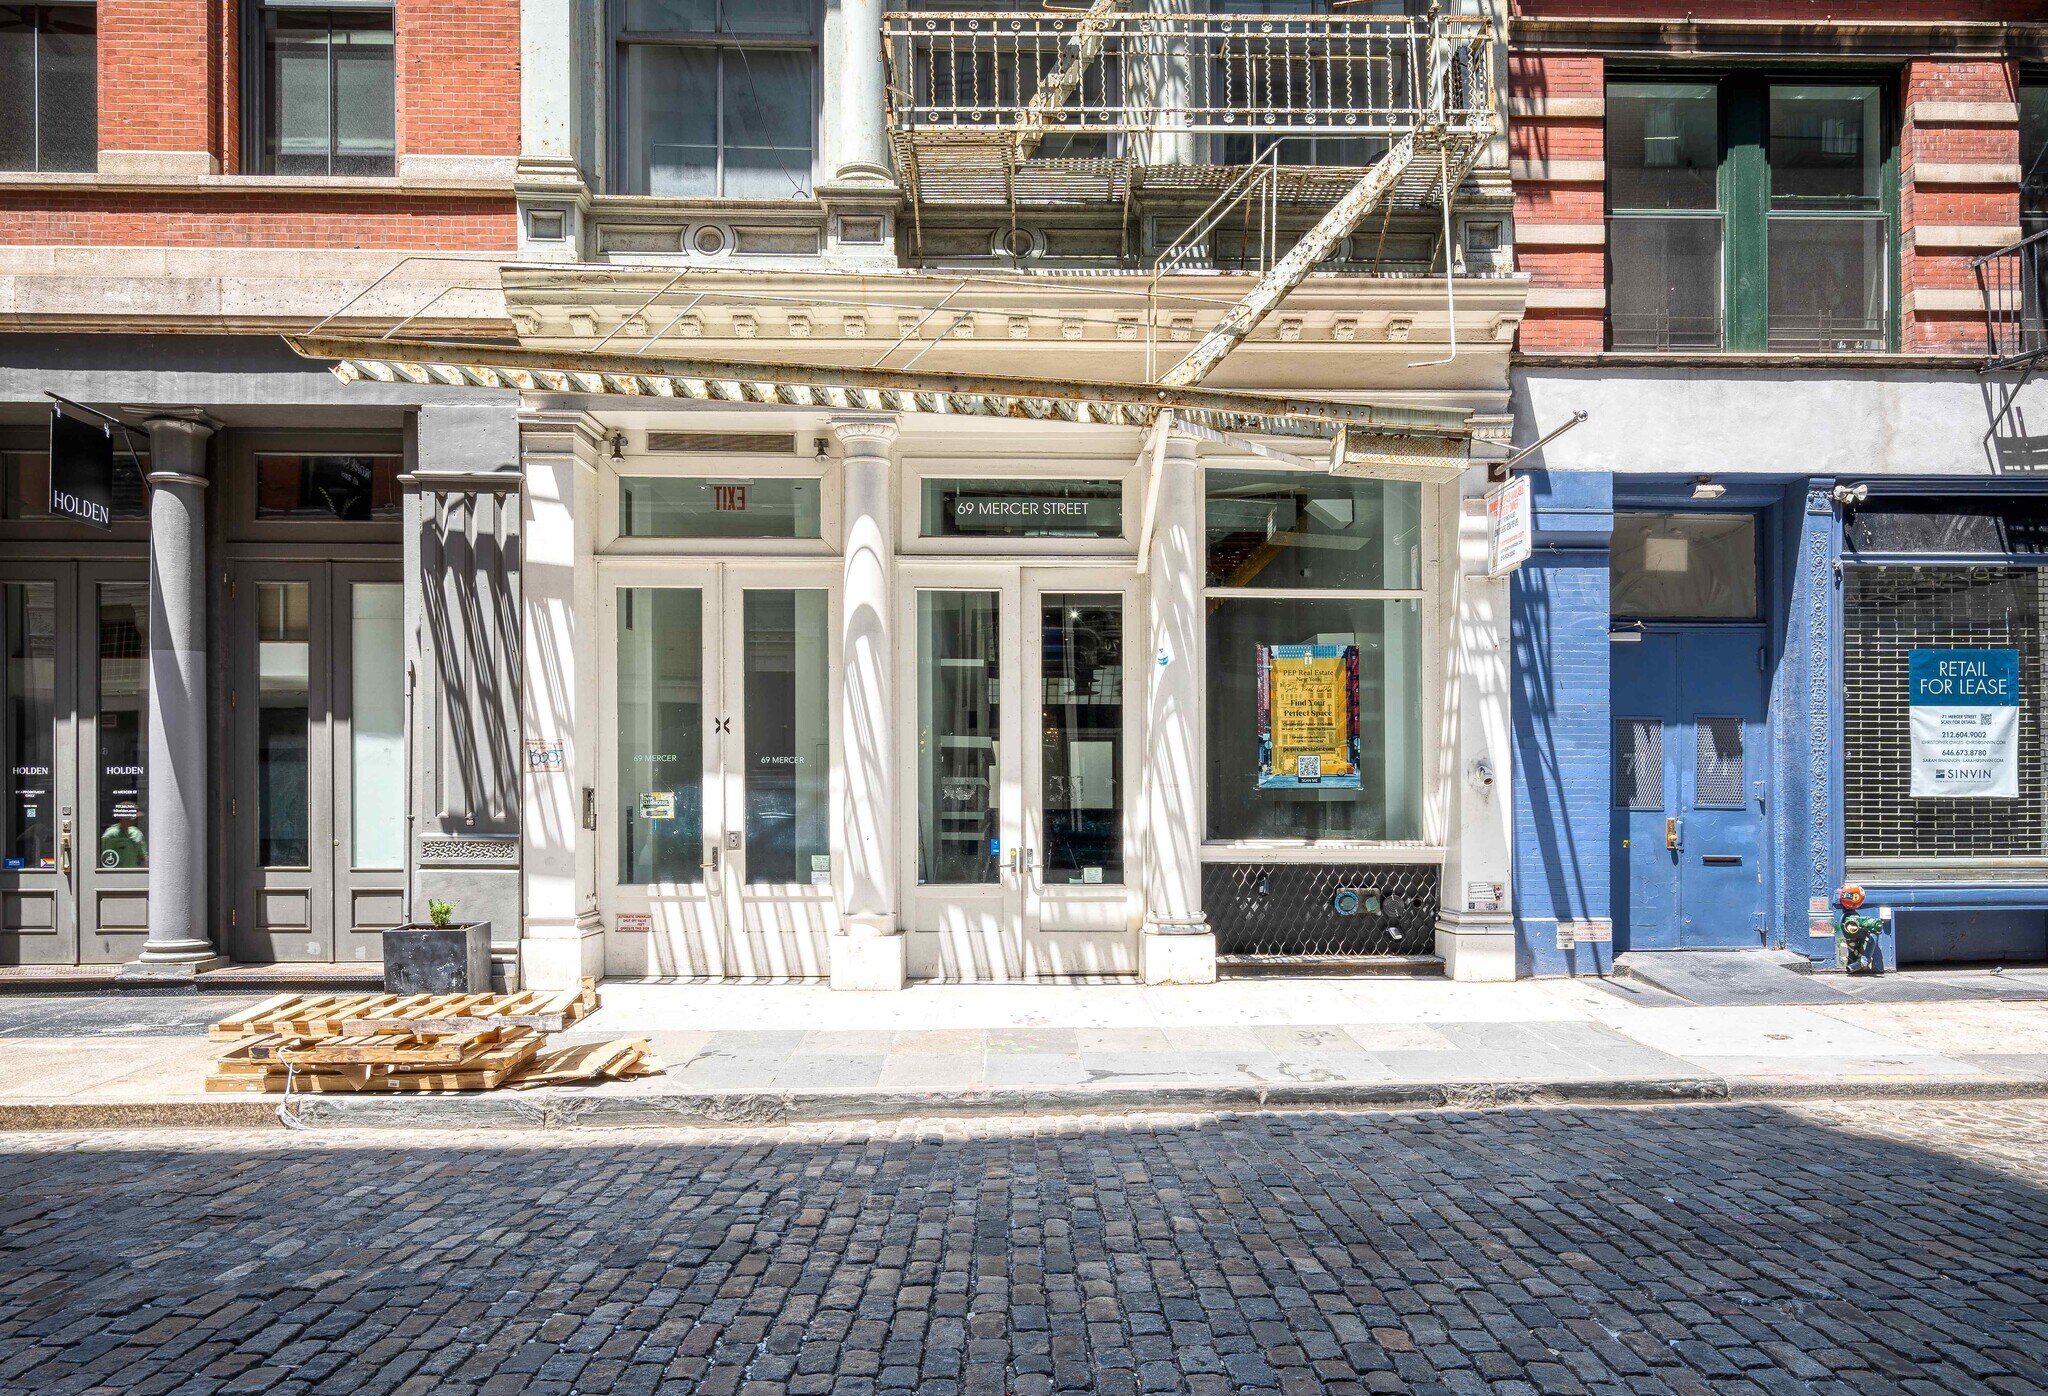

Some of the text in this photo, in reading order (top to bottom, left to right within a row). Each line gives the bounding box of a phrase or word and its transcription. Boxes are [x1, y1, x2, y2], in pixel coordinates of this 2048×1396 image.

[54, 490, 109, 524] HOLDEN
[957, 502, 1089, 515] 69 MERCER STREET
[1939, 660, 1989, 677] RETAIL
[1920, 679, 2007, 695] FOR LEASE
[1284, 709, 1333, 718] Perfect Space
[633, 754, 677, 762] 69 MERCER
[760, 756, 805, 764] 69 MERCER
[12, 766, 49, 775] HOLDEN
[106, 766, 144, 775] HOLDEN
[1947, 769, 1992, 779] SINVIN
